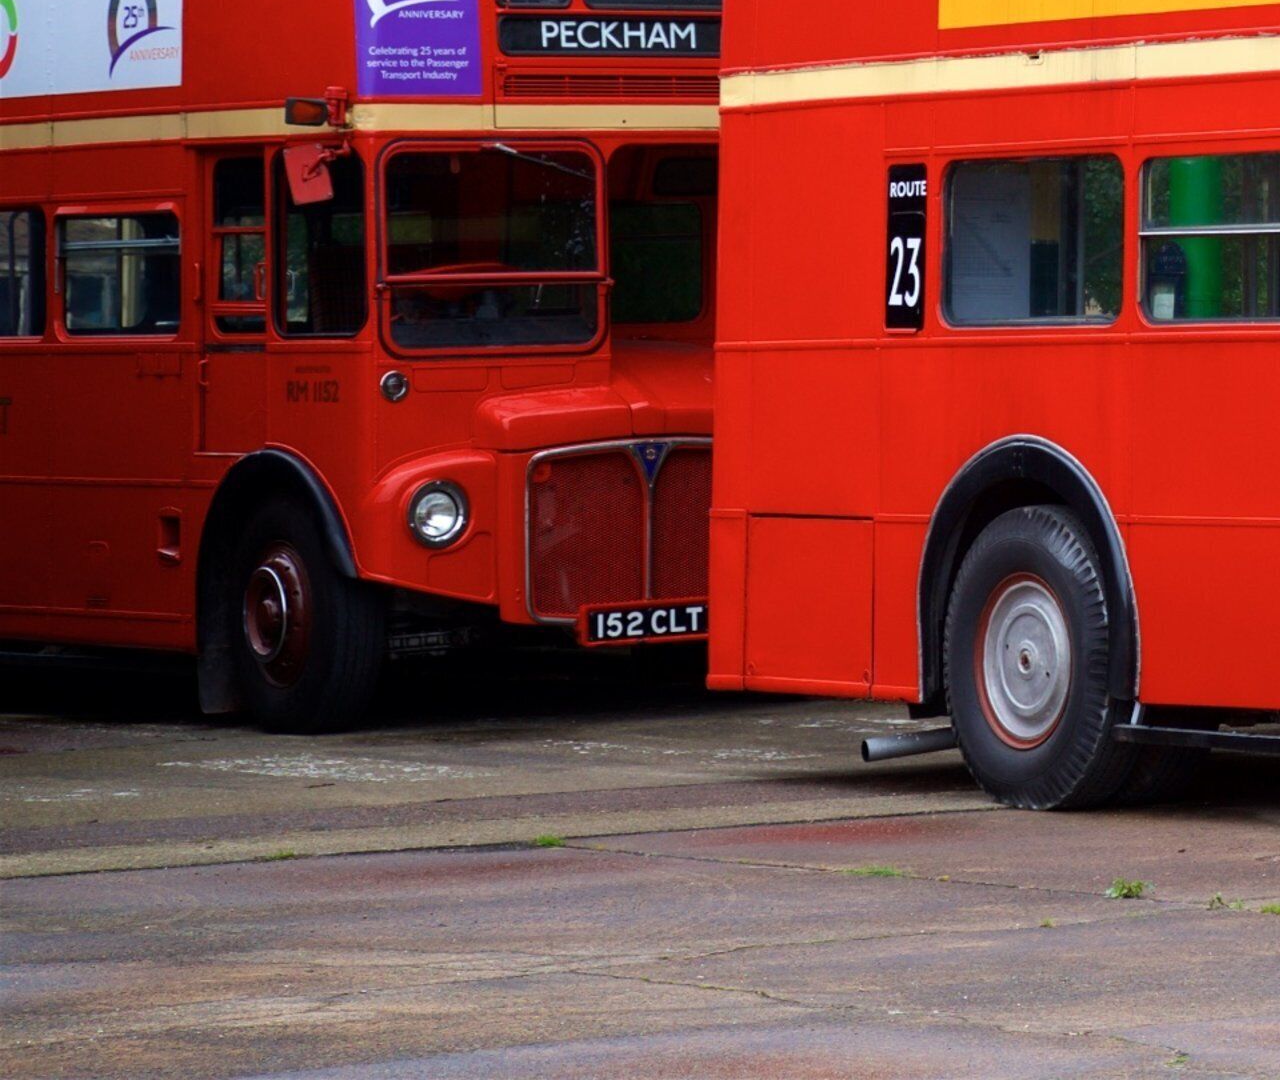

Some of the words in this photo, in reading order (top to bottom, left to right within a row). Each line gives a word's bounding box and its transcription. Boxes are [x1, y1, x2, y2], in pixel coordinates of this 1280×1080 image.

[398, 9, 464, 19] ANNIVERSARY
[540, 21, 696, 49] PECKHAM
[130, 45, 180, 62] ANNIVERSARY
[368, 46, 418, 57] Celebrating
[420, 46, 431, 56] 25
[433, 47, 455, 56] years
[457, 46, 467, 55] of
[366, 58, 398, 67] service
[399, 59, 409, 67] to
[410, 58, 425, 67] the
[426, 58, 469, 69] Passenger
[380, 70, 421, 80] Transport
[422, 70, 458, 80] Industry
[889, 180, 928, 198] ROUTE
[888, 236, 922, 307] 23
[286, 380, 309, 402] RM
[312, 379, 340, 403] 1152
[597, 611, 644, 638] 152
[650, 607, 703, 633] CLT
